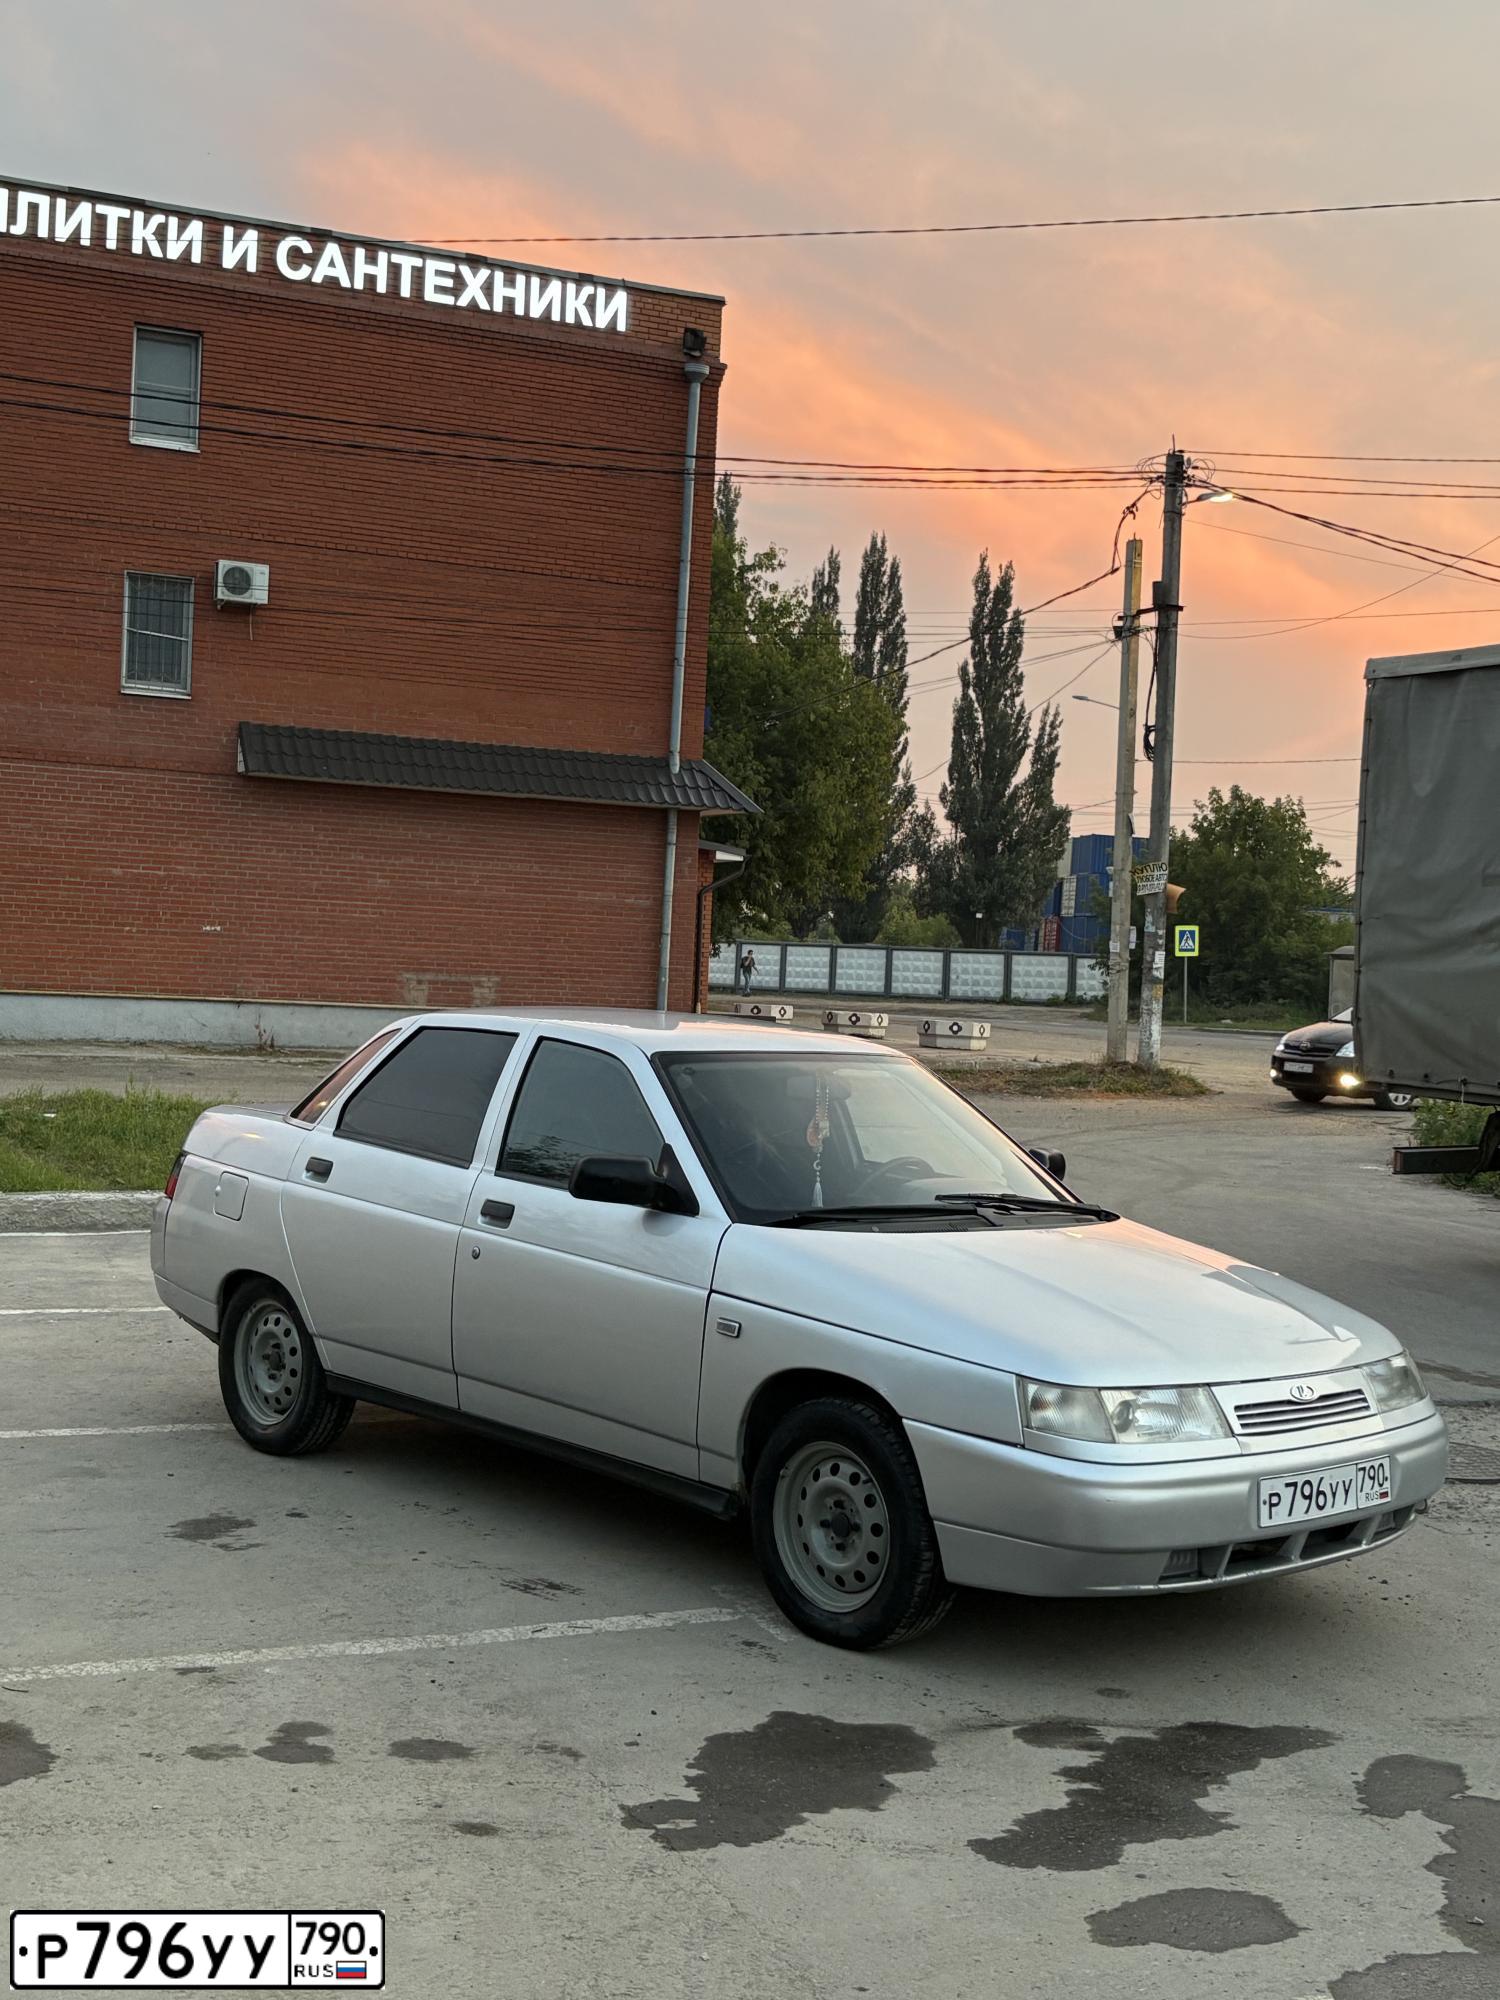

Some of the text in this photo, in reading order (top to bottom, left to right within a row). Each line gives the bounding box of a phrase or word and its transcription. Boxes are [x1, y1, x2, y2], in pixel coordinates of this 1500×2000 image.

[0, 188, 627, 333] ЛИТКИ И САНТЕХНИКИ
[1268, 1463, 1385, 1520] Р796УУ 790
[1364, 1491, 1379, 1502] RUS
